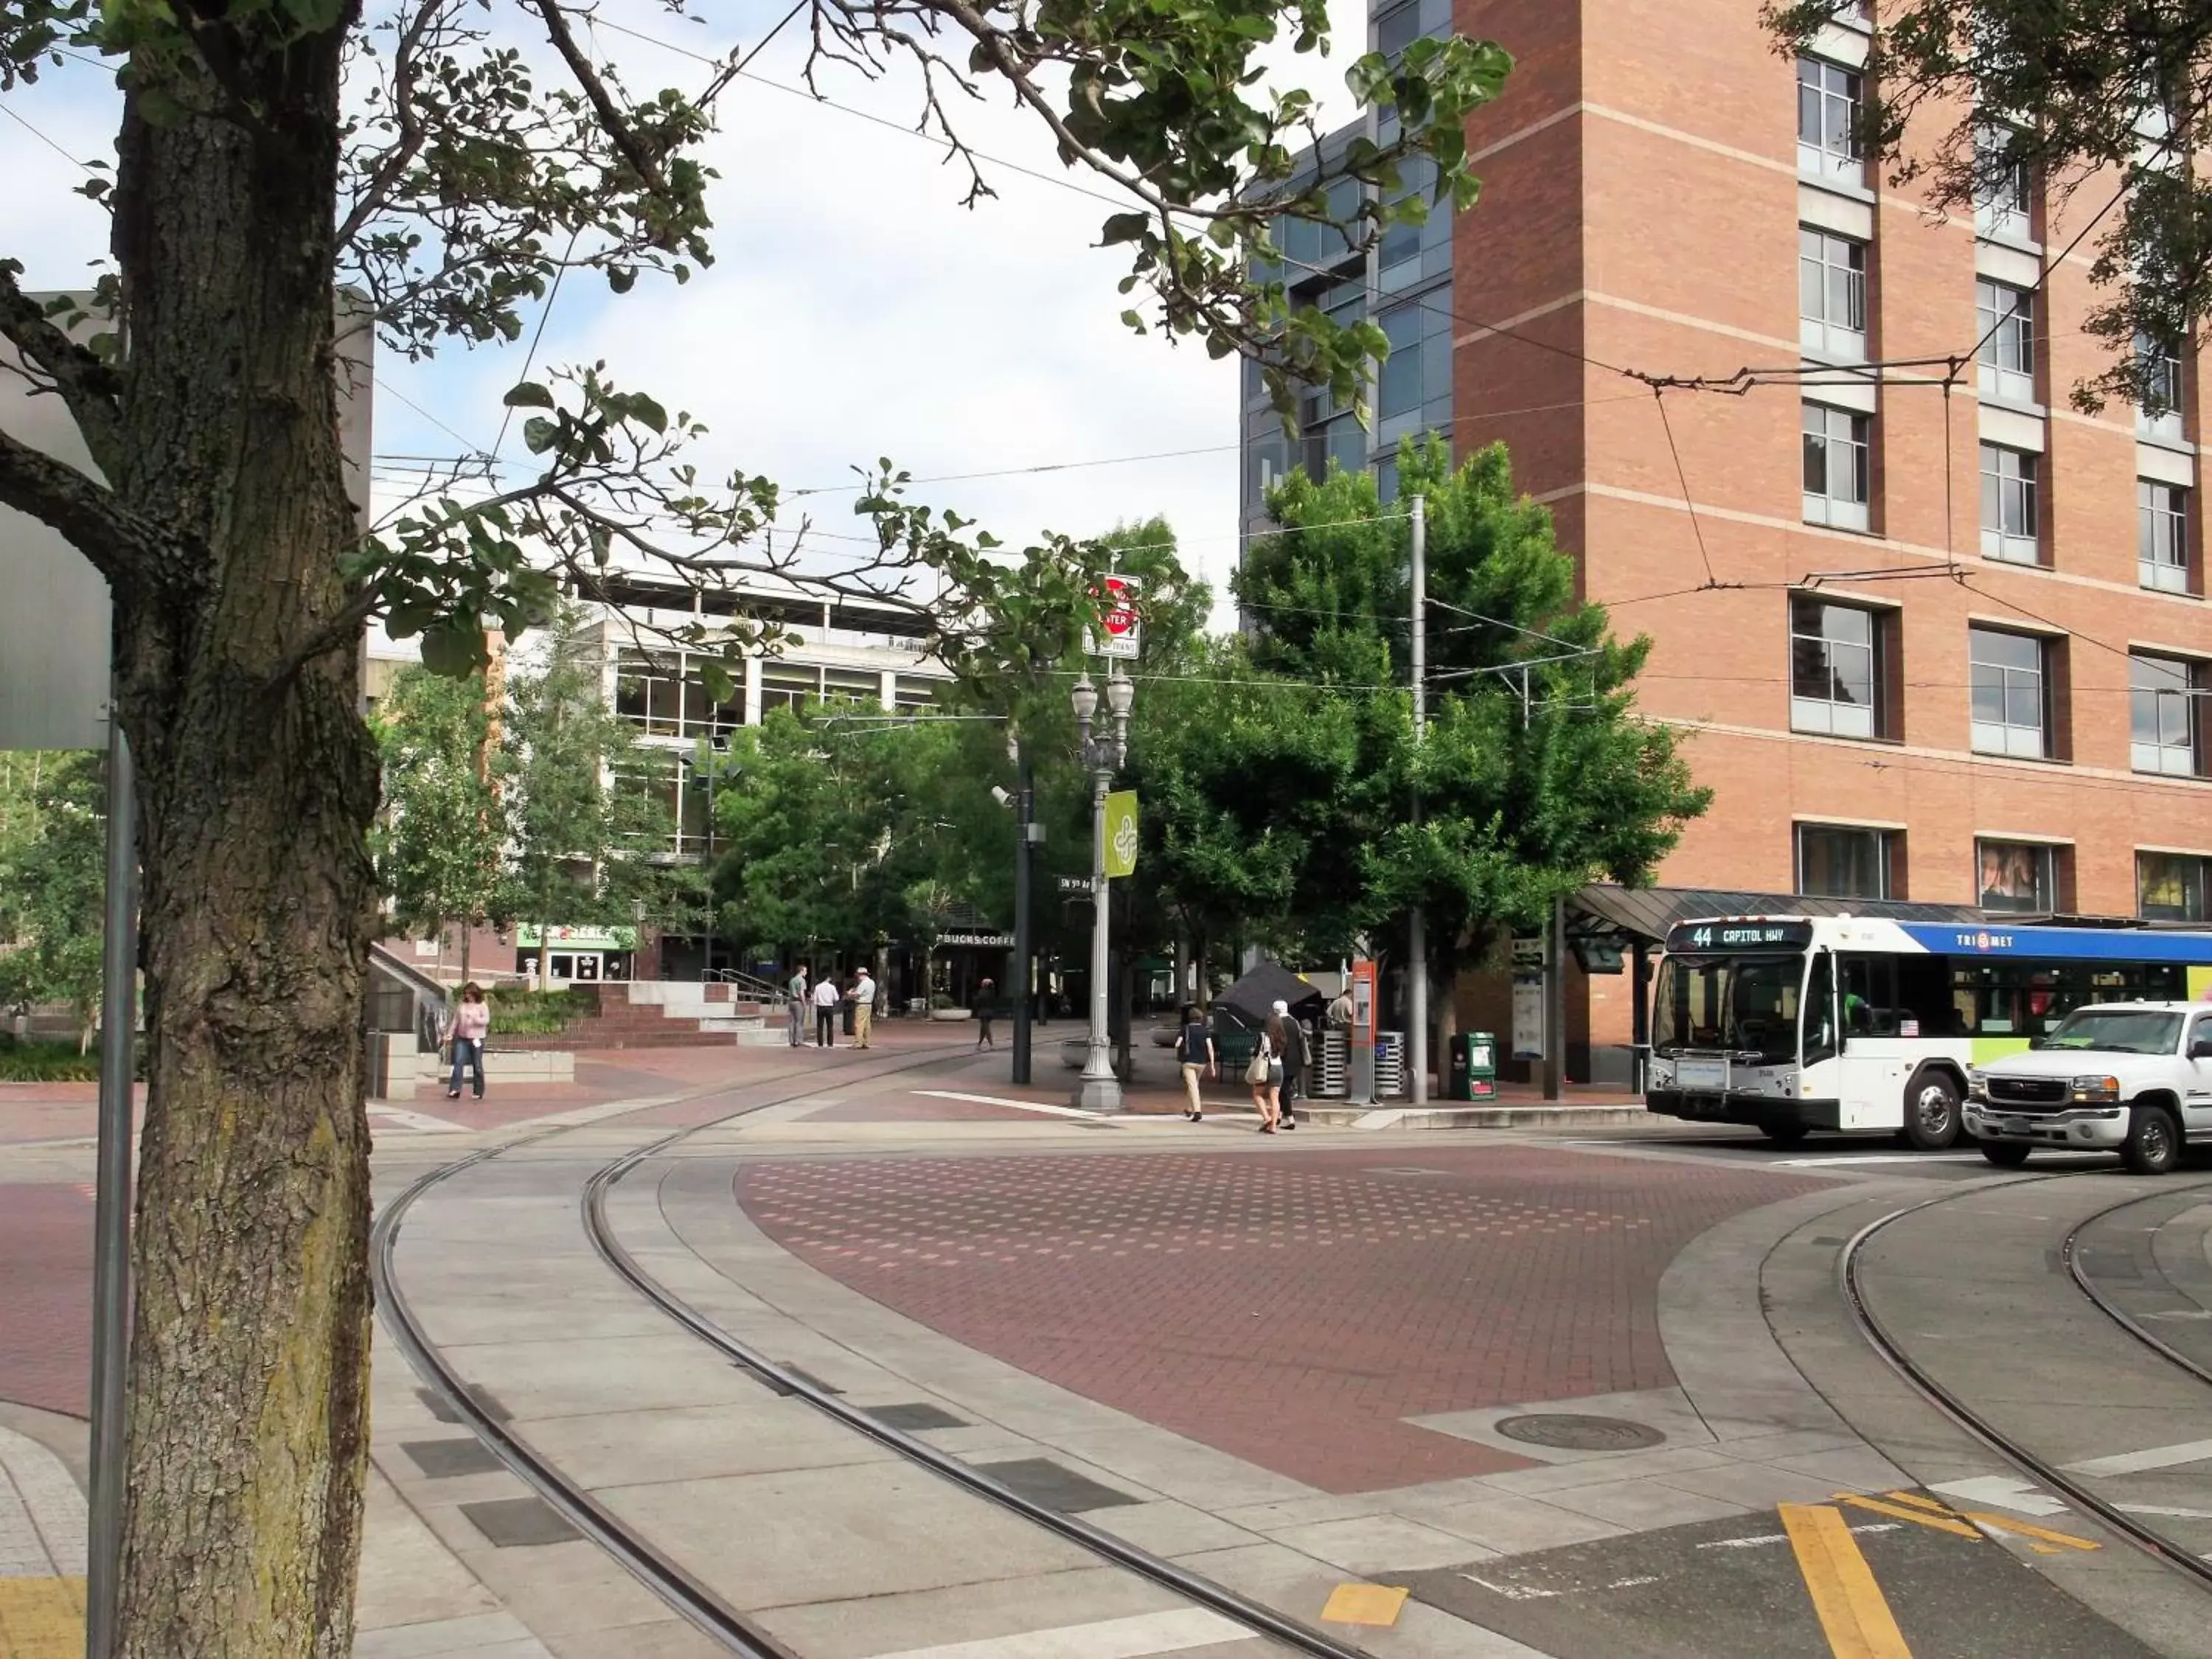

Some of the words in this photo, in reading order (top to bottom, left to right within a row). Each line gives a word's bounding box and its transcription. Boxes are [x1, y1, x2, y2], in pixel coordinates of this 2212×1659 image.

[1694, 927, 1711, 947] 44
[1723, 930, 1762, 943] CAPITOL
[1766, 928, 1784, 942] HWY
[1990, 935, 2013, 947] MET
